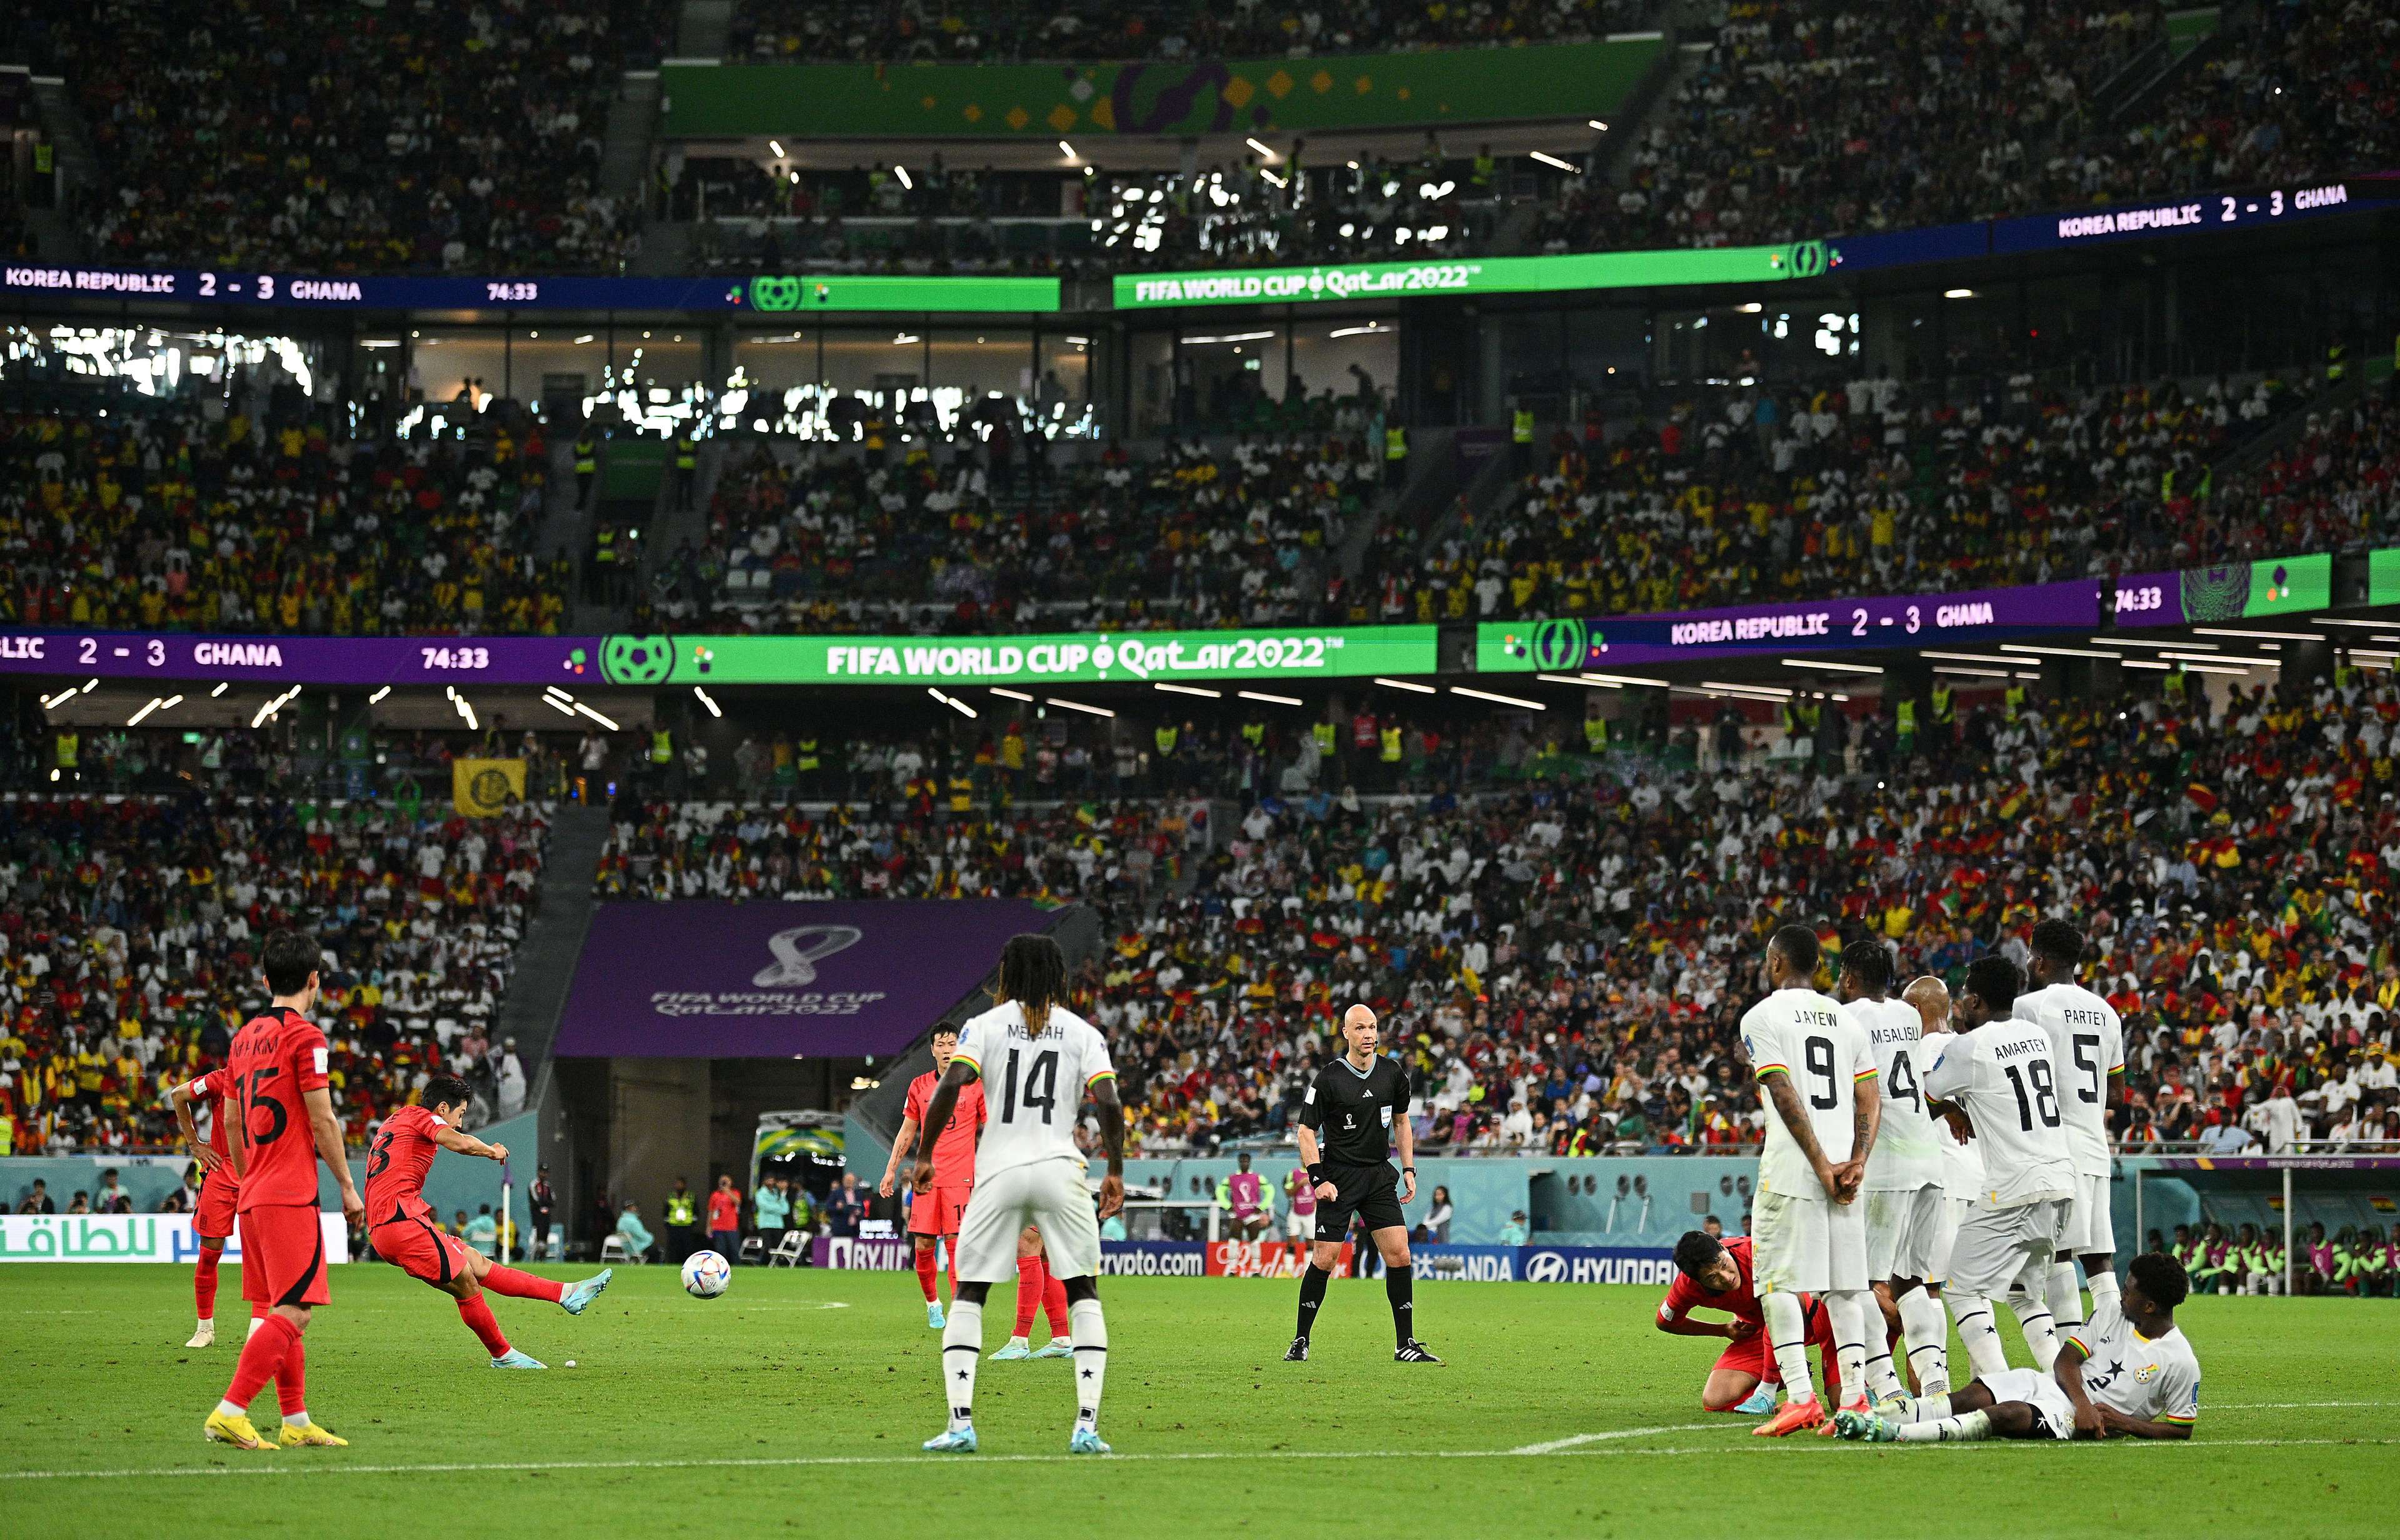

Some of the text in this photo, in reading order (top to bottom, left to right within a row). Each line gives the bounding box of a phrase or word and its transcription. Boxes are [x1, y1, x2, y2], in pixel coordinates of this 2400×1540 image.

[2059, 211, 2116, 238] KOREA
[2117, 204, 2202, 232] REPUBLIC
[2221, 197, 2237, 222] 2
[2270, 191, 2284, 216] 3
[2294, 184, 2348, 210] GHANA
[6, 268, 72, 288] KOREA
[76, 271, 175, 294] REPUBLIC
[199, 272, 217, 296] 2
[258, 276, 275, 299] 3
[291, 281, 362, 301] GHANA
[487, 282, 538, 301] 74:33
[1136, 282, 1182, 301] FIFA
[1183, 277, 1261, 299] WORLD
[1263, 276, 1307, 296] CUP
[1671, 620, 1733, 645] KOREA
[1735, 612, 1829, 639] REPUBLIC
[1852, 608, 1868, 636] 2
[1906, 606, 1921, 634] 3
[1936, 601, 1994, 629] GHANA
[2114, 586, 2162, 613] 74:33
[0, 636, 45, 659] LIC
[79, 638, 97, 664] 2
[148, 639, 166, 667] 3
[194, 642, 282, 667] GHANA
[421, 648, 489, 669] 74:33
[827, 646, 901, 675] FIFA
[903, 646, 1024, 676] WORLD
[1027, 644, 1089, 674] CUP
[651, 991, 887, 1003] FIFA WORLD CUP
[1795, 1010, 1838, 1027] J.AYEW
[2064, 1009, 2106, 1026] PARTEY
[1871, 1027, 1919, 1045] M.SALISU
[1994, 1038, 2047, 1061] AMARTEY
[1805, 1036, 1838, 1111] 9
[1887, 1050, 1920, 1114] 4
[2072, 1034, 2100, 1104] 5
[1002, 1048, 1059, 1126] 14
[2004, 1059, 2061, 1132] 18
[234, 1066, 288, 1149] 15
